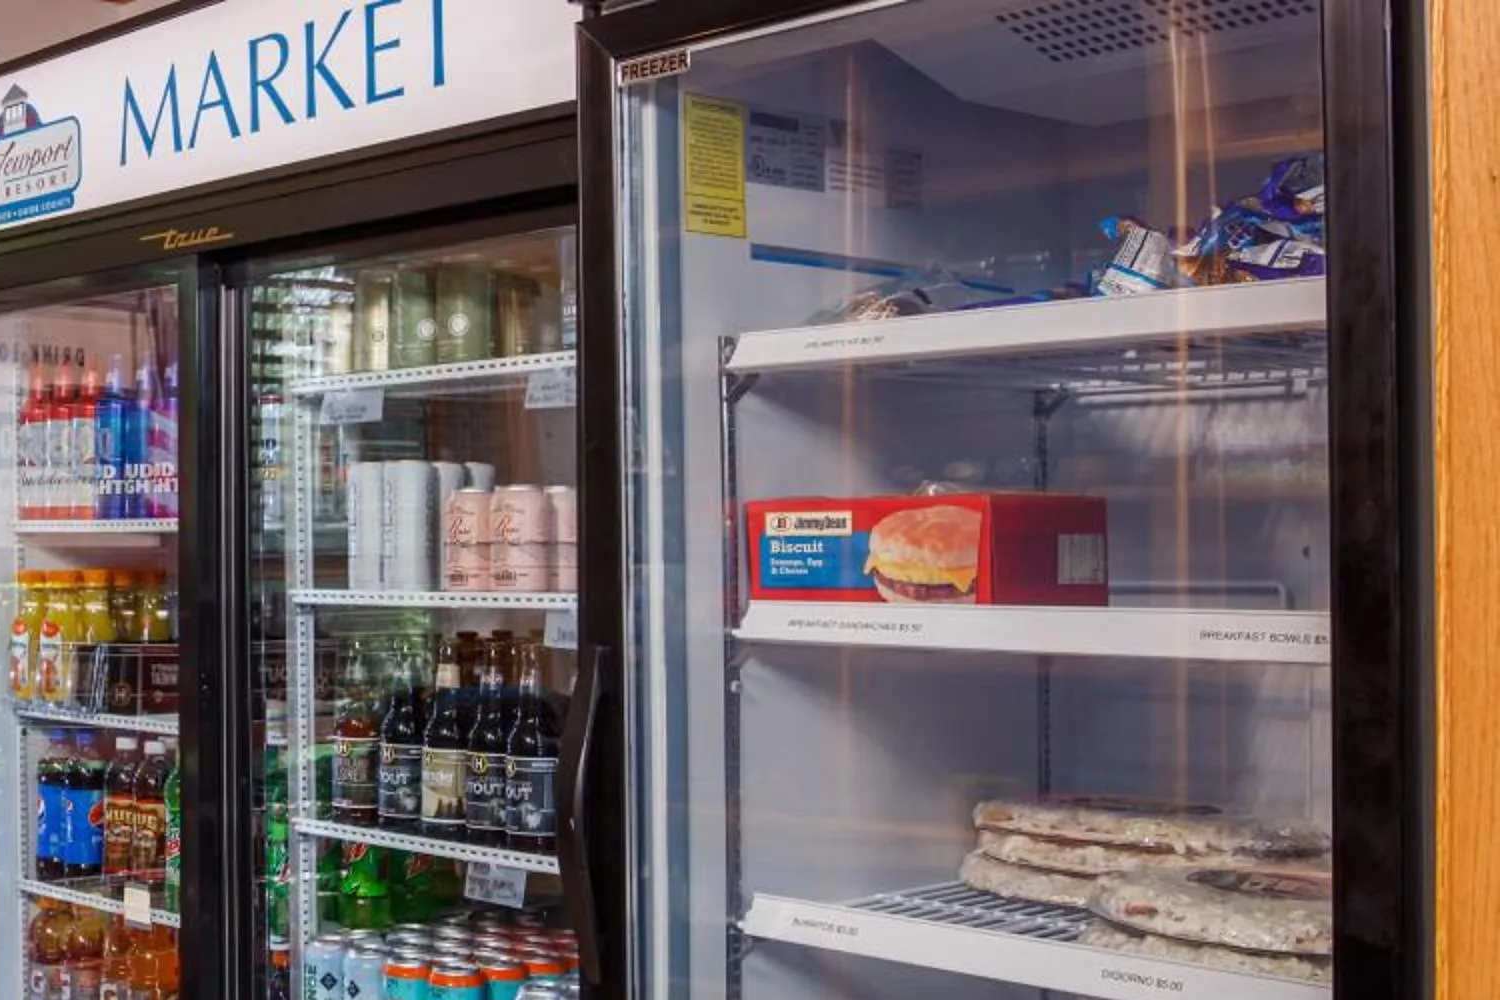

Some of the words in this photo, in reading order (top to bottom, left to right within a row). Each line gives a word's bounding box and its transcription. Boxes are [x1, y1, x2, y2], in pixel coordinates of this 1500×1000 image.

[621, 52, 688, 82] FREEZER
[119, 0, 447, 166] MARKET
[5, 170, 68, 198] RESORT
[770, 539, 824, 553] Biscuit
[1199, 630, 1266, 641] BREAKFAST
